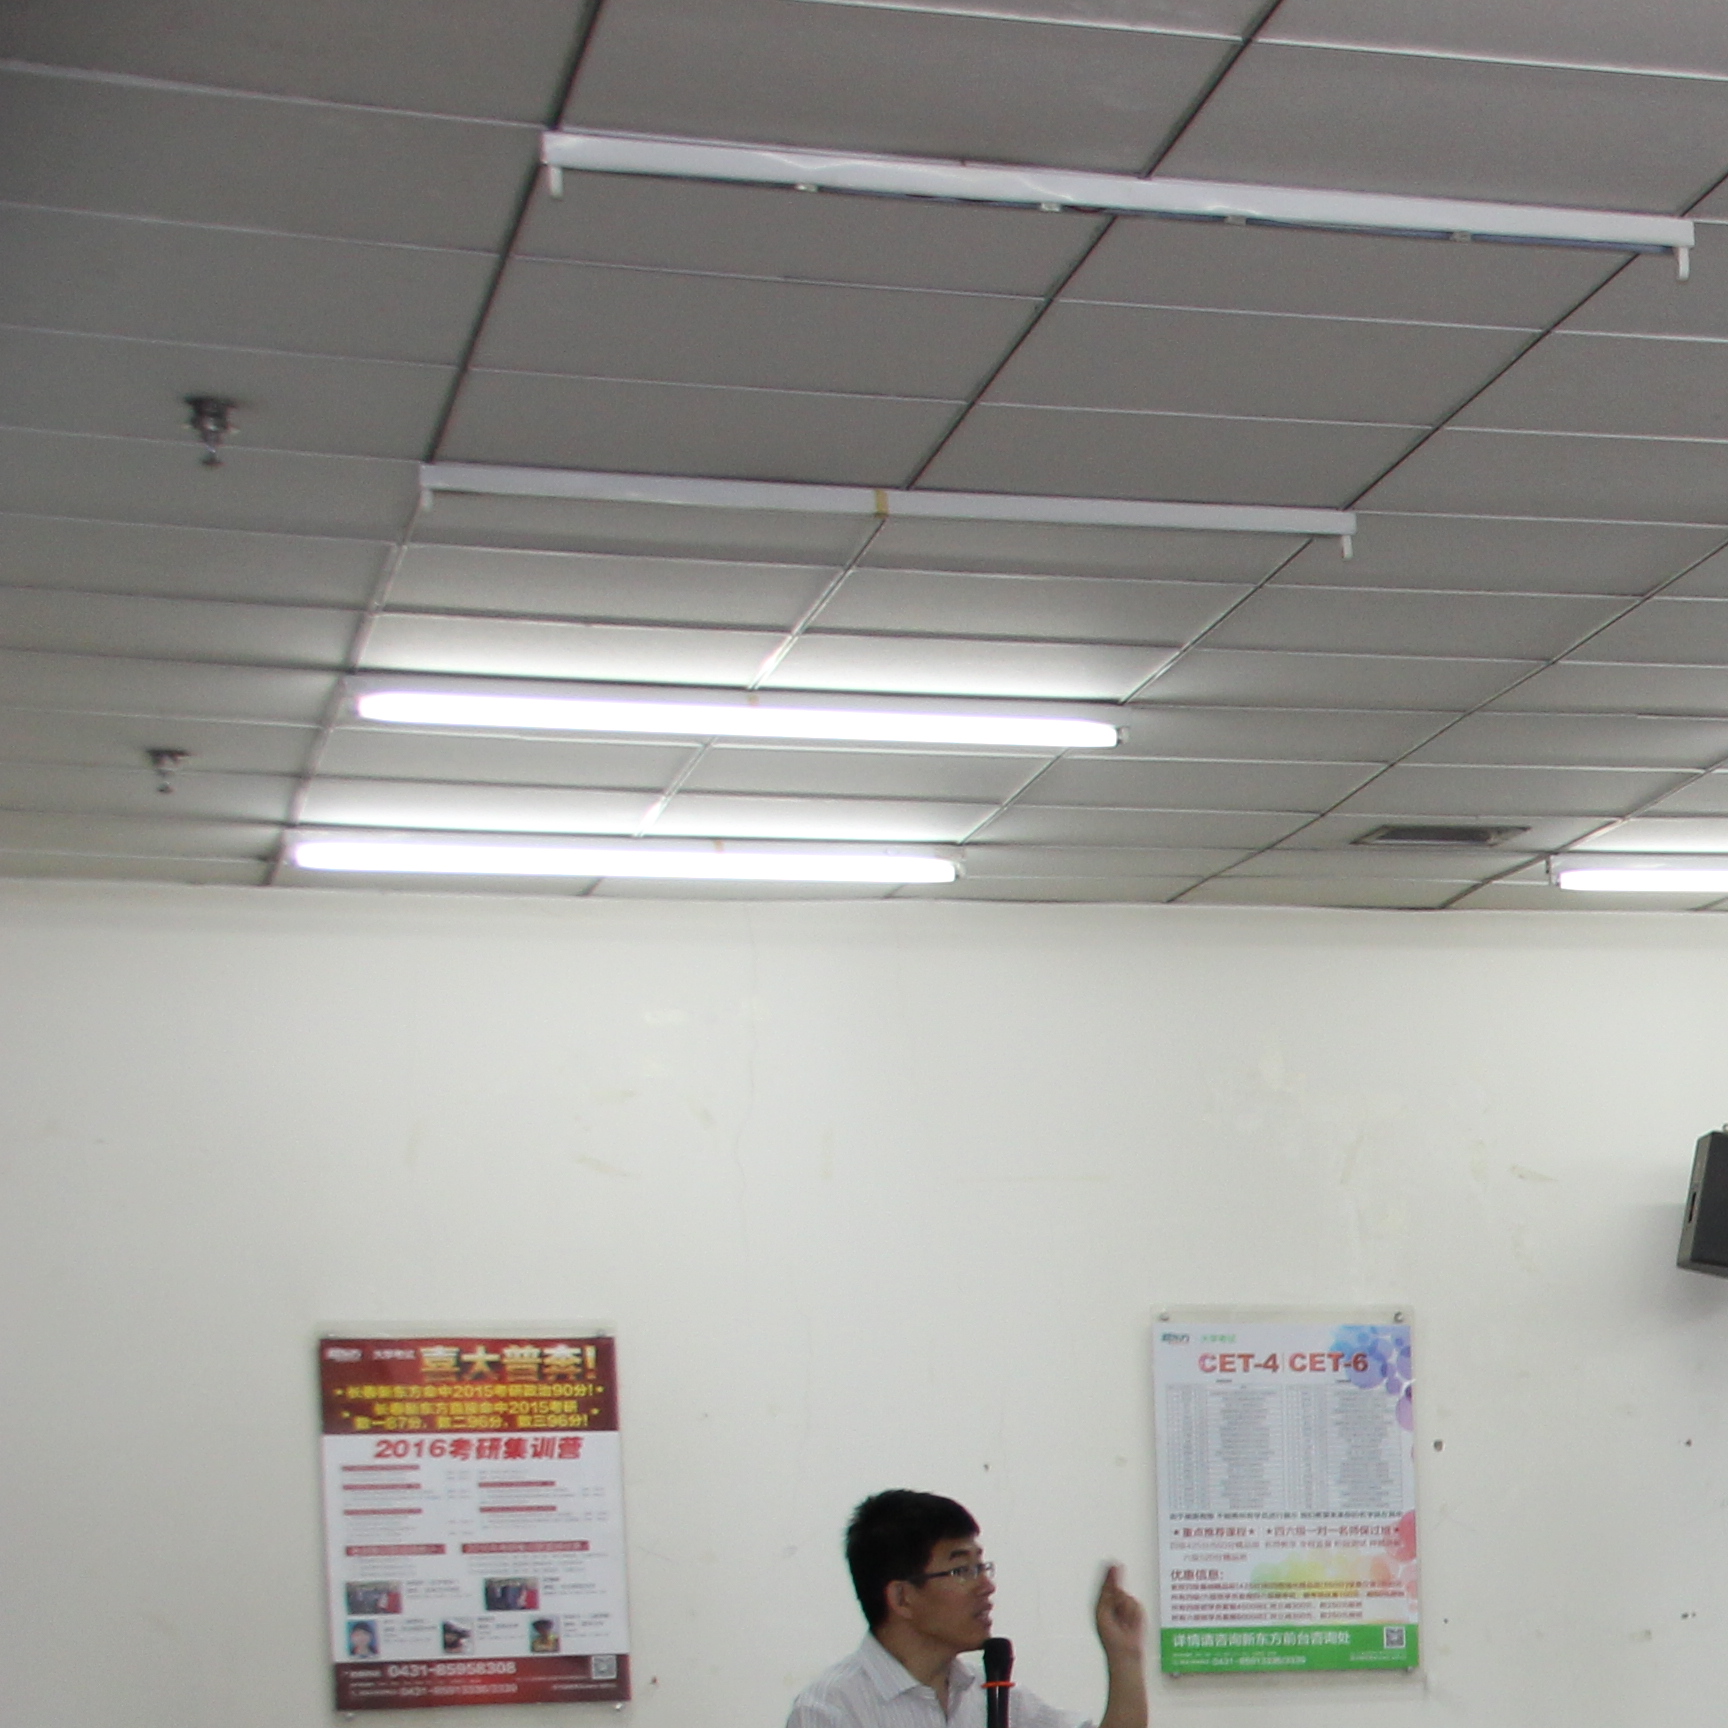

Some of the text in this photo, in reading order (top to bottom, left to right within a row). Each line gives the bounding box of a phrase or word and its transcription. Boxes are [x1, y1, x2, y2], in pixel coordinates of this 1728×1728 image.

[1198, 1351, 1369, 1373] CET-4 CET-6
[374, 1436, 585, 1460] 2016考研集训营
